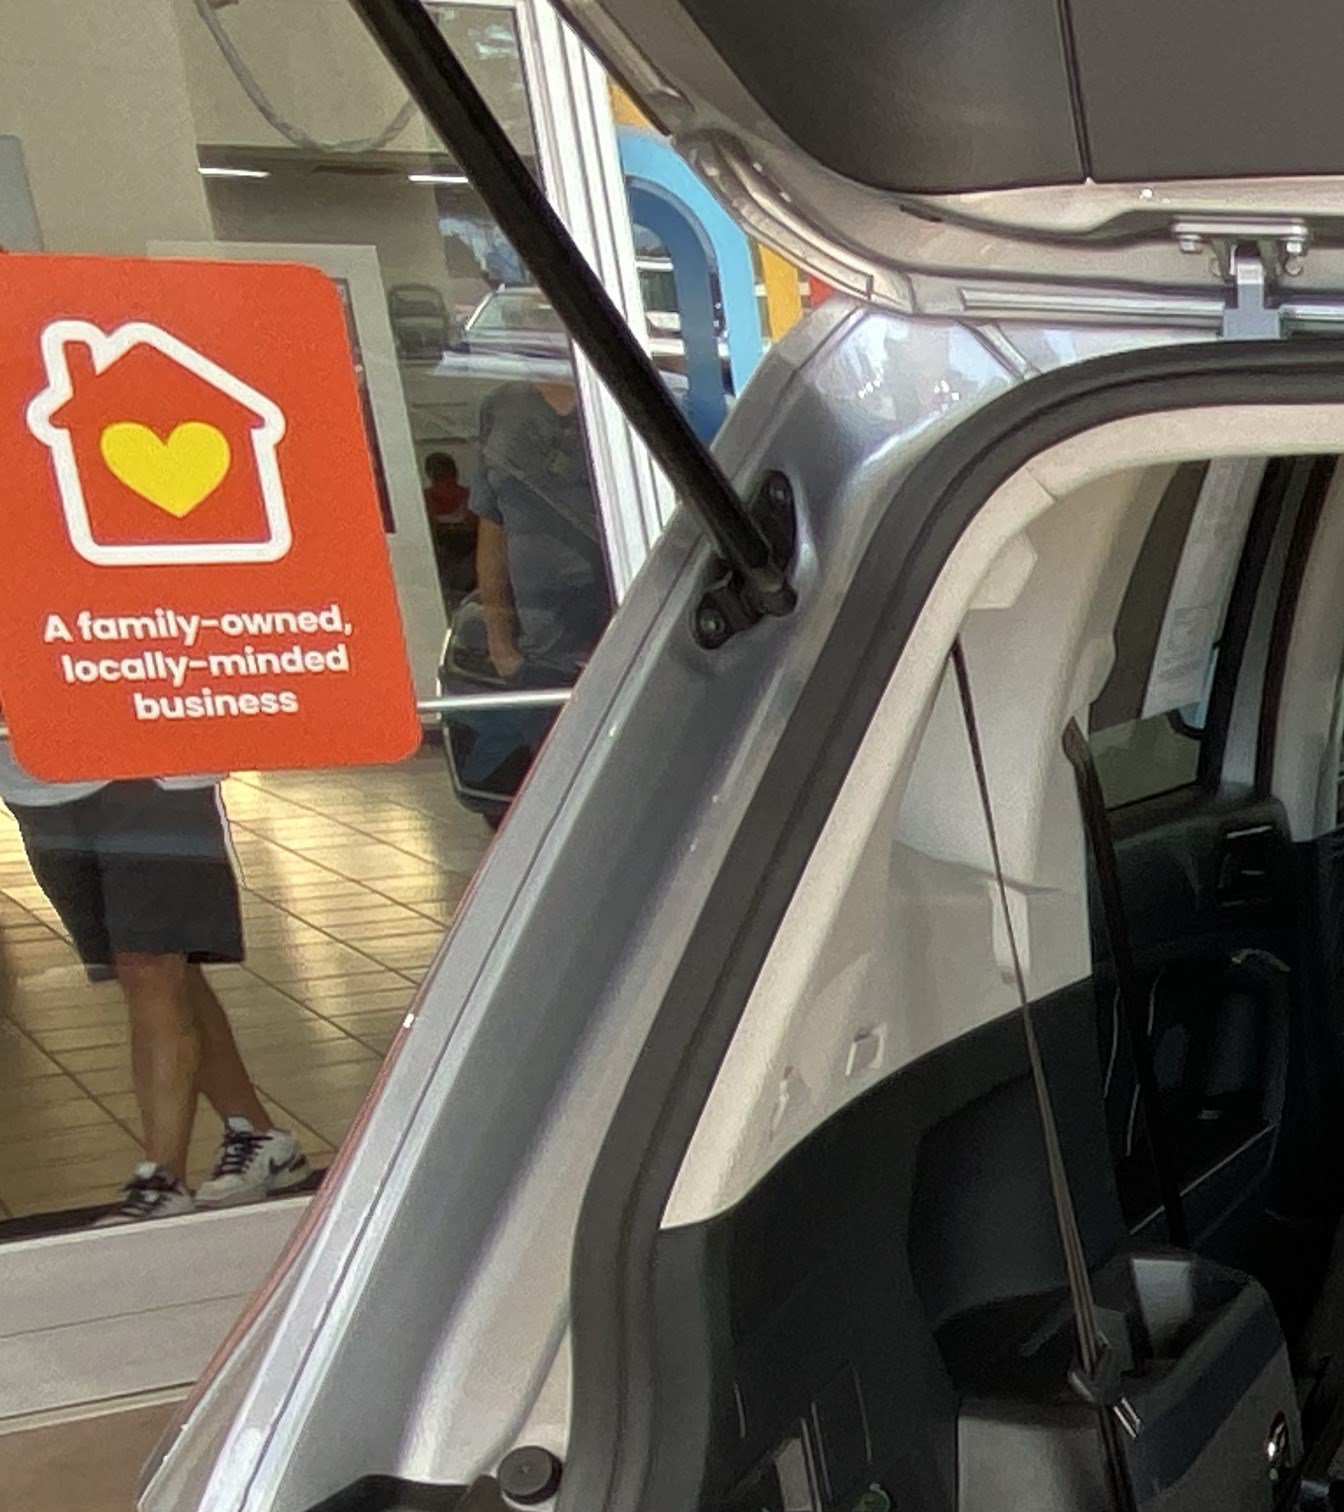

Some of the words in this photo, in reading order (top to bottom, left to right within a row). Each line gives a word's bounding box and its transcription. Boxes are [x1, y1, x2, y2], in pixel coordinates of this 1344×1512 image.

[44, 614, 73, 642] A
[76, 604, 352, 646] family-owned,
[60, 643, 350, 687] locally-minded
[132, 687, 299, 720] business
